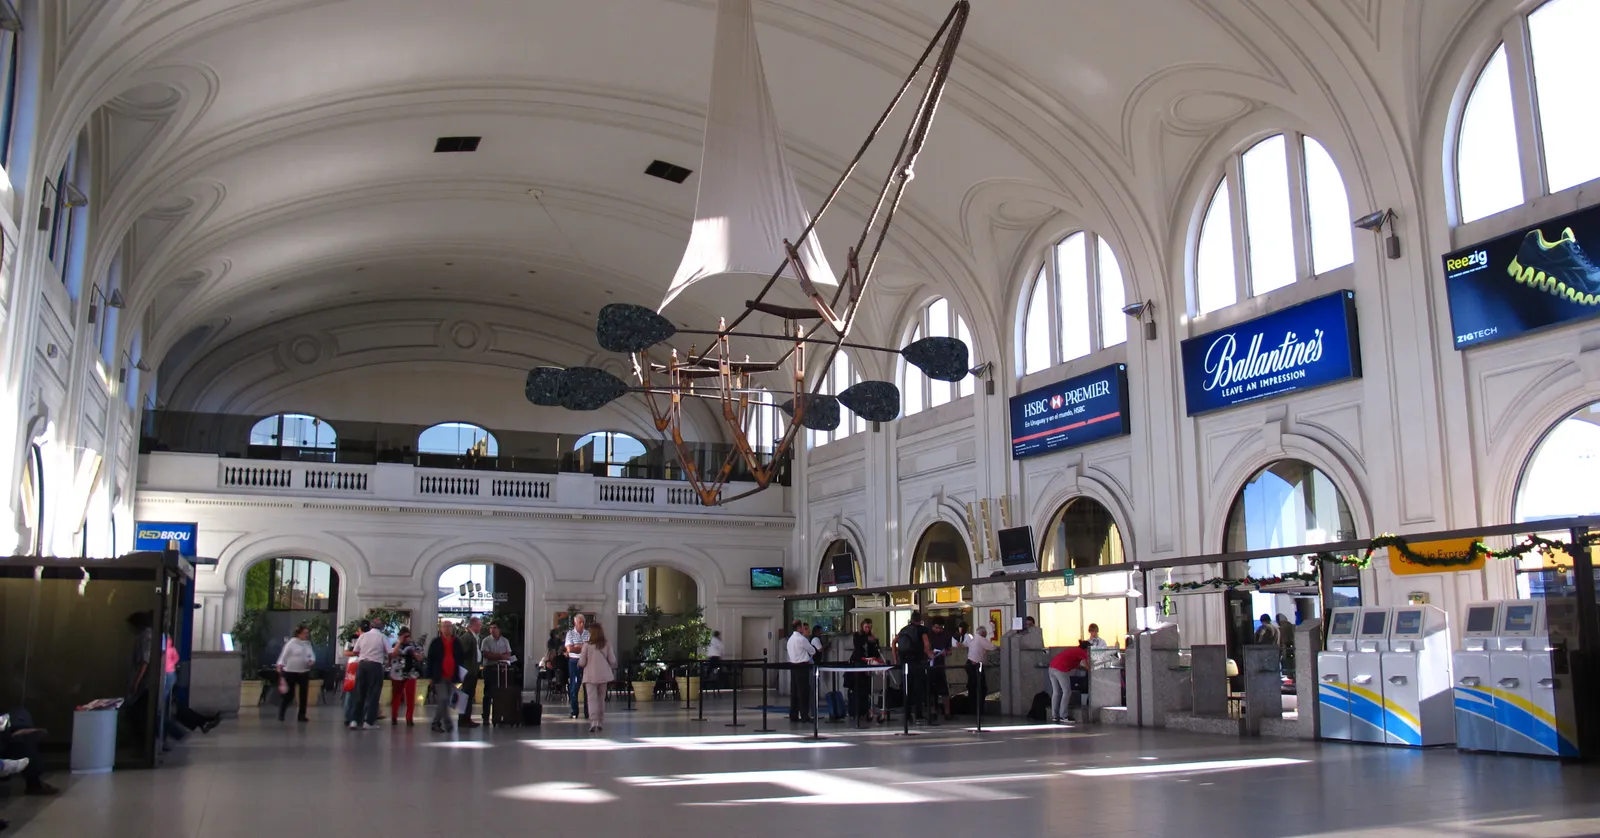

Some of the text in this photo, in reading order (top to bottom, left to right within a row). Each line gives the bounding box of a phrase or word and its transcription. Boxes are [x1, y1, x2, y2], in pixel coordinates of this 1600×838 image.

[1447, 250, 1488, 271] Reezig
[1457, 326, 1498, 343] ZIGTECH
[1202, 328, 1324, 391] Ballantine's
[1222, 384, 1243, 397] LEAVE
[1246, 381, 1257, 391] AN
[1260, 369, 1306, 390] IMPRESSION
[1024, 380, 1110, 418] HSBC PREMIER
[1030, 418, 1046, 428] Uruguay
[1073, 405, 1086, 415] HSBC
